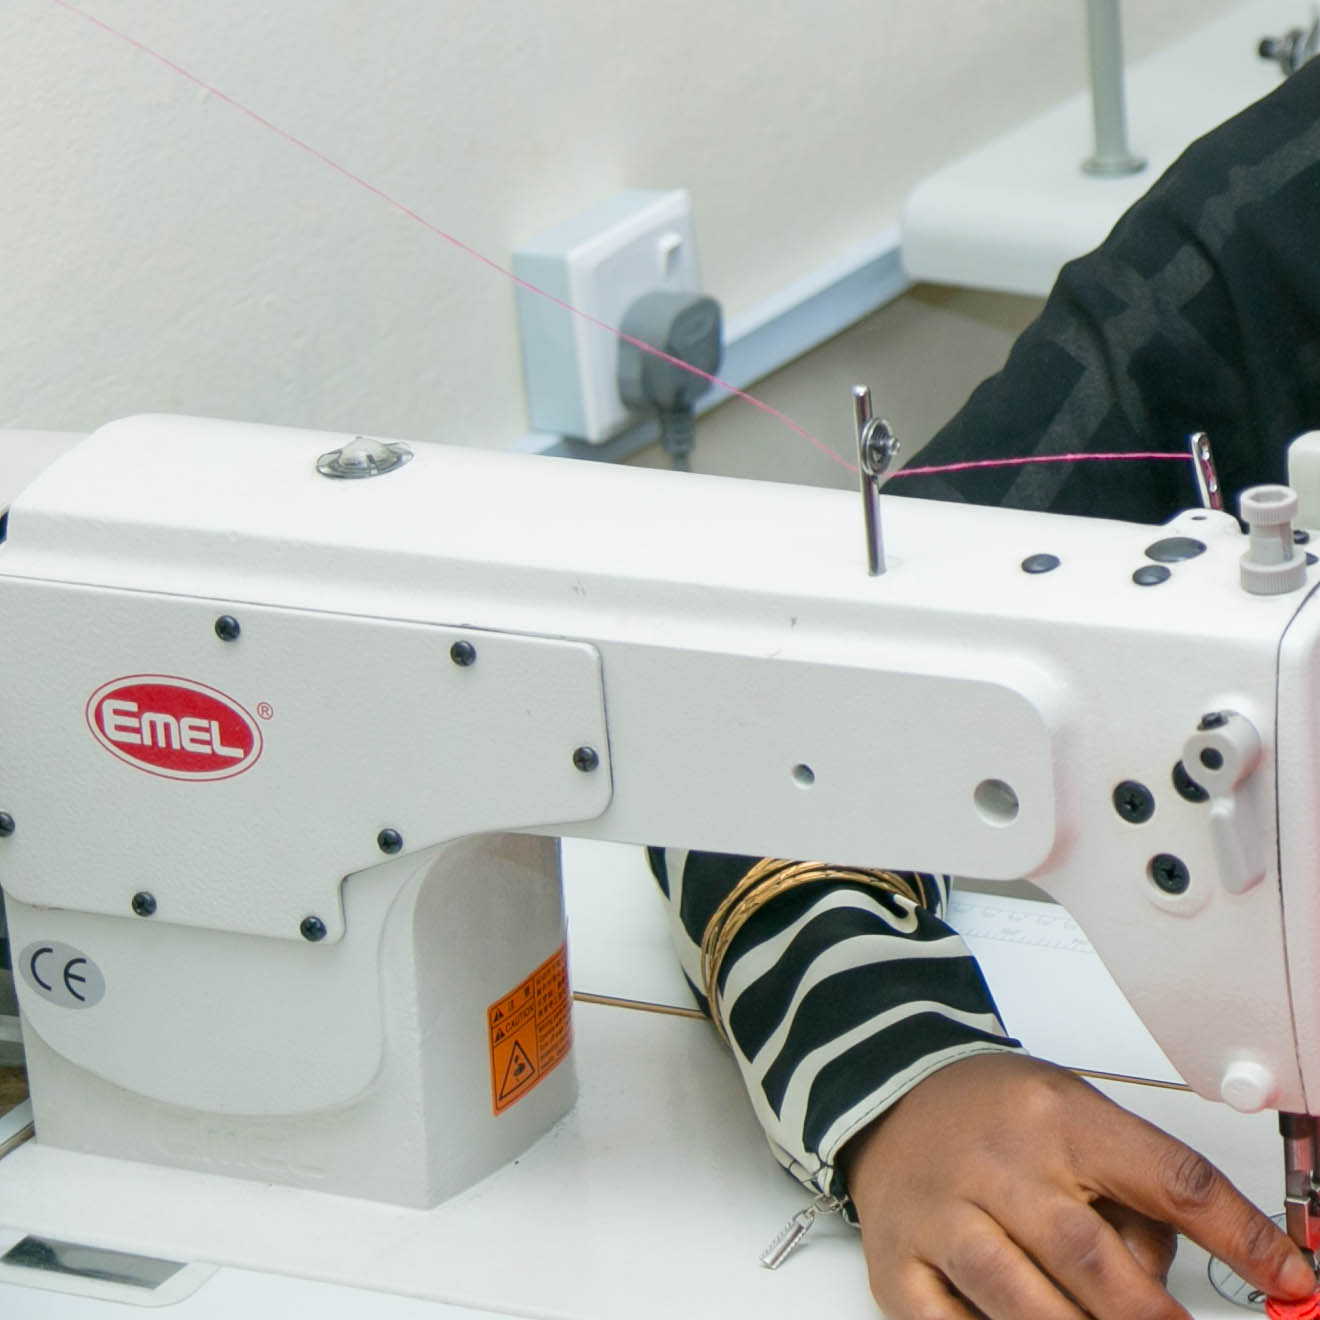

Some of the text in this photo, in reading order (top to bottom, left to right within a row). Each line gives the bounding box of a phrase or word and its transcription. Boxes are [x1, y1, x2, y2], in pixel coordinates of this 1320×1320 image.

[102, 698, 244, 758] EMEL
[30, 947, 87, 1001] CE
[505, 1002, 535, 1033] CAUTION
